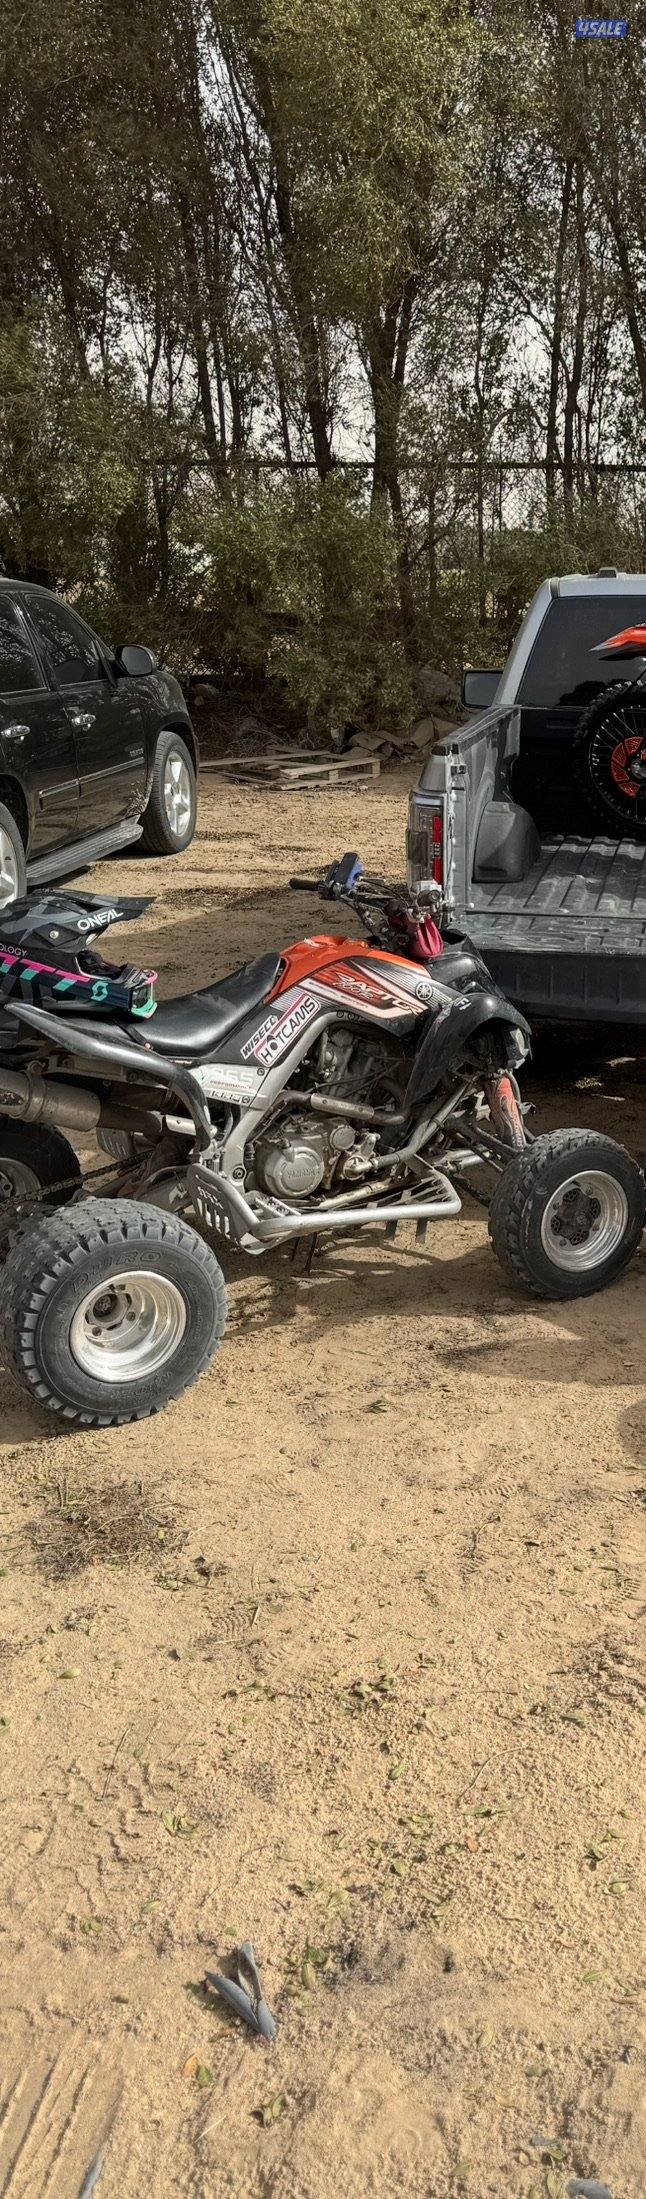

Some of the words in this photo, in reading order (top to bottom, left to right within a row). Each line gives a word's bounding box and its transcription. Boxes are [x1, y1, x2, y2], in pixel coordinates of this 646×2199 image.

[77, 908, 124, 930] ONEAL
[335, 971, 425, 1016] RAPTOR
[261, 997, 316, 1063] HOTCAMS
